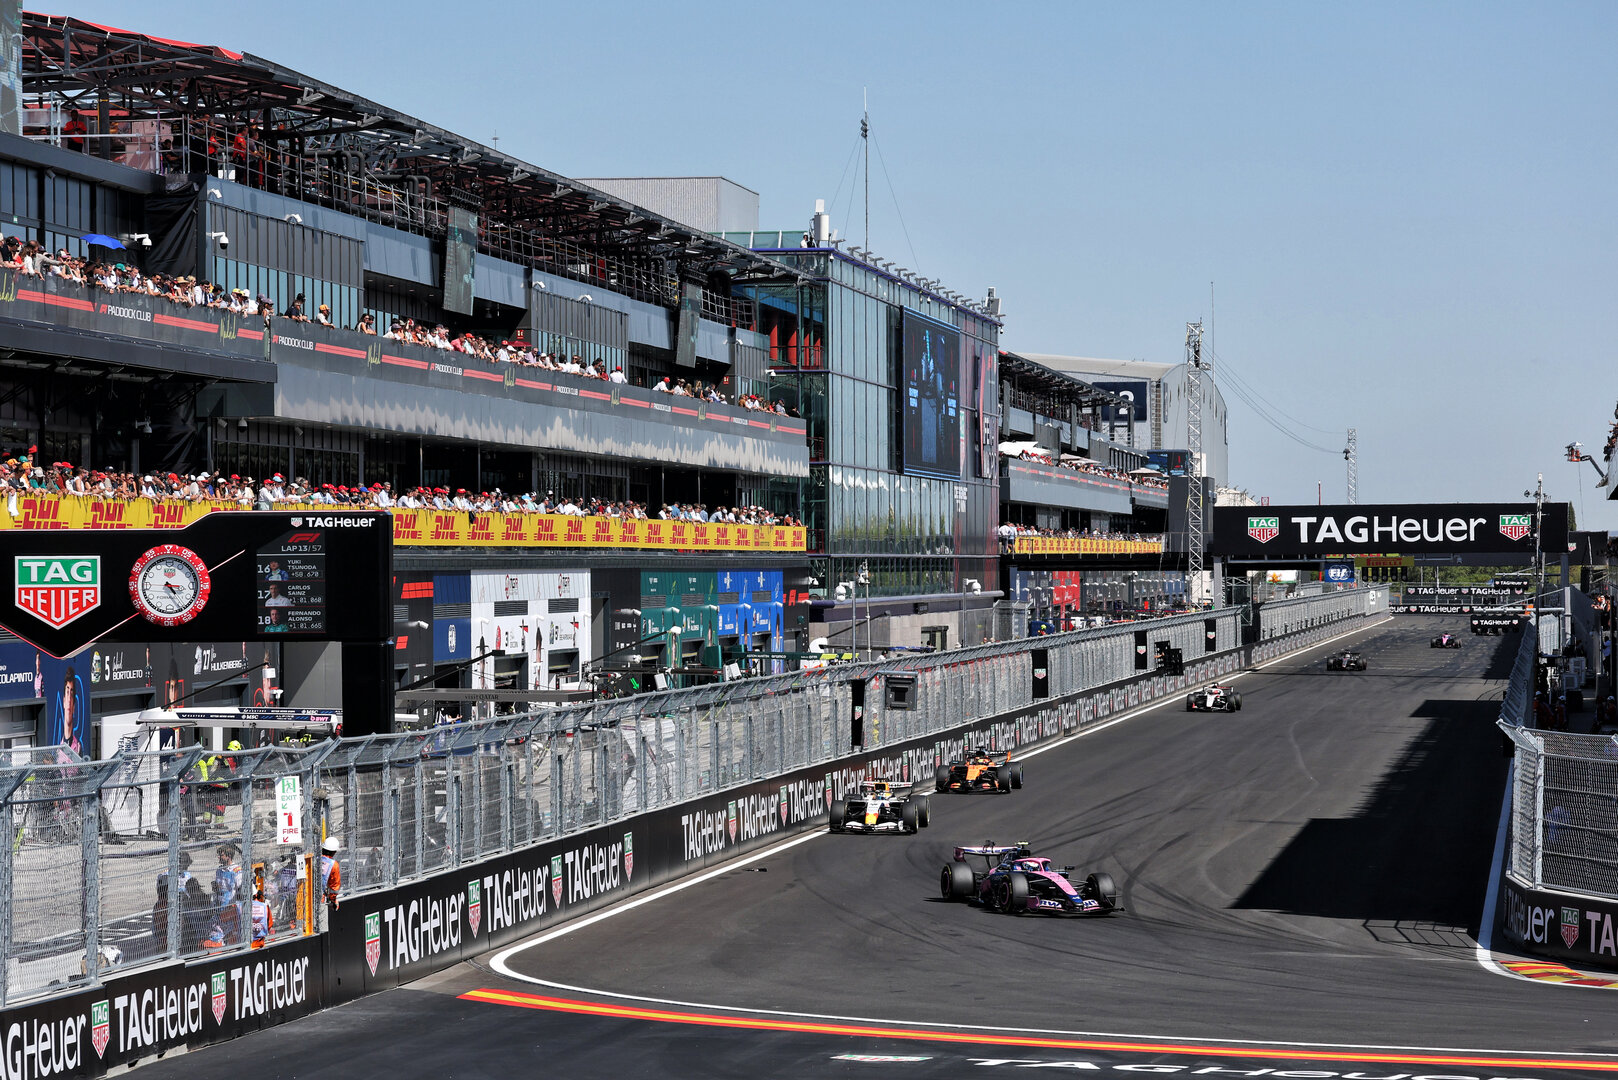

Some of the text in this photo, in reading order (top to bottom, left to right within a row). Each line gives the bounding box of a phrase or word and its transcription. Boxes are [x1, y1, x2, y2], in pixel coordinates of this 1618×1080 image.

[108, 305, 135, 319] PADDOCK
[136, 307, 151, 322] CLUB
[279, 336, 301, 349] PADDOCK
[301, 339, 313, 350] CLUB
[435, 364, 453, 375] PADDOCK
[453, 366, 462, 376] CLUB
[306, 517, 375, 527] TAGHeuer
[435, 515, 455, 540] DHL
[505, 518, 523, 540] DHL
[537, 519, 554, 541] DHL
[1250, 518, 1277, 527] TAG
[1291, 515, 1487, 544] TAGHeuer
[1501, 516, 1530, 525] TAG
[1249, 529, 1278, 541] HEUER
[22, 561, 92, 582] TAG
[257, 565, 271, 574] 16
[257, 591, 271, 599] 17
[21, 589, 95, 623] HEUER
[258, 616, 271, 625] 18
[104, 656, 110, 681] 5
[203, 649, 211, 671] 27
[113, 669, 143, 680] BORTOLETO
[788, 777, 825, 825] TAGHeuer
[737, 793, 779, 841] TAGHeuer
[681, 808, 727, 861] TAGHeuer
[564, 841, 622, 904] TAGHeuer
[468, 882, 480, 903] TAG
[483, 864, 549, 933] TAGHeuer
[366, 914, 380, 938] TAG
[1562, 910, 1578, 924] TAG
[384, 891, 465, 970] TAGHeuer
[1562, 926, 1579, 945] HEUER
[1586, 911, 1618, 957] TA
[212, 973, 226, 992] TAG
[230, 955, 309, 1021] TAGHeuer
[92, 1003, 108, 1023] TAG
[114, 981, 207, 1052] TAGHeuer
